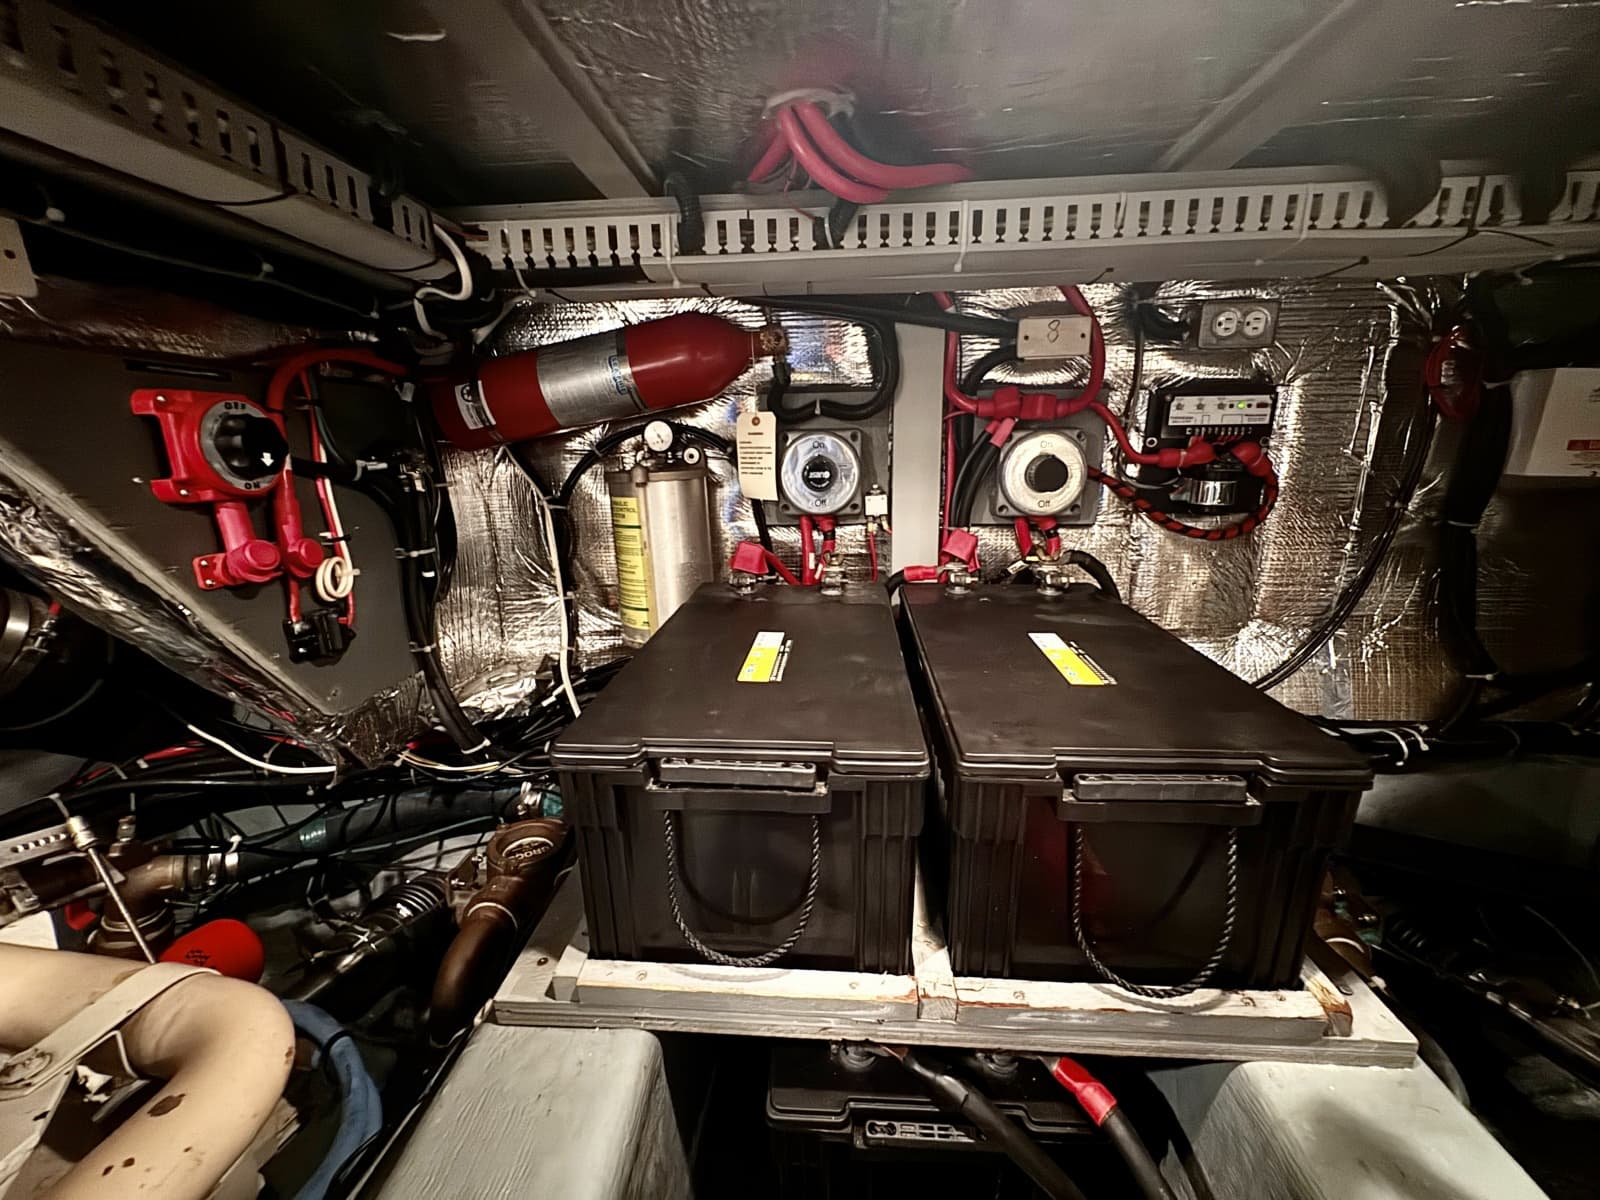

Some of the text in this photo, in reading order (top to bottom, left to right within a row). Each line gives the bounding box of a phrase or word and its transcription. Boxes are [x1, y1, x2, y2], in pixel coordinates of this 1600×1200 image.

[1047, 319, 1061, 344] 8
[812, 440, 825, 449] On
[1040, 440, 1054, 449] On
[244, 481, 261, 490] ON
[814, 499, 827, 508] Off
[1037, 500, 1051, 508] Off
